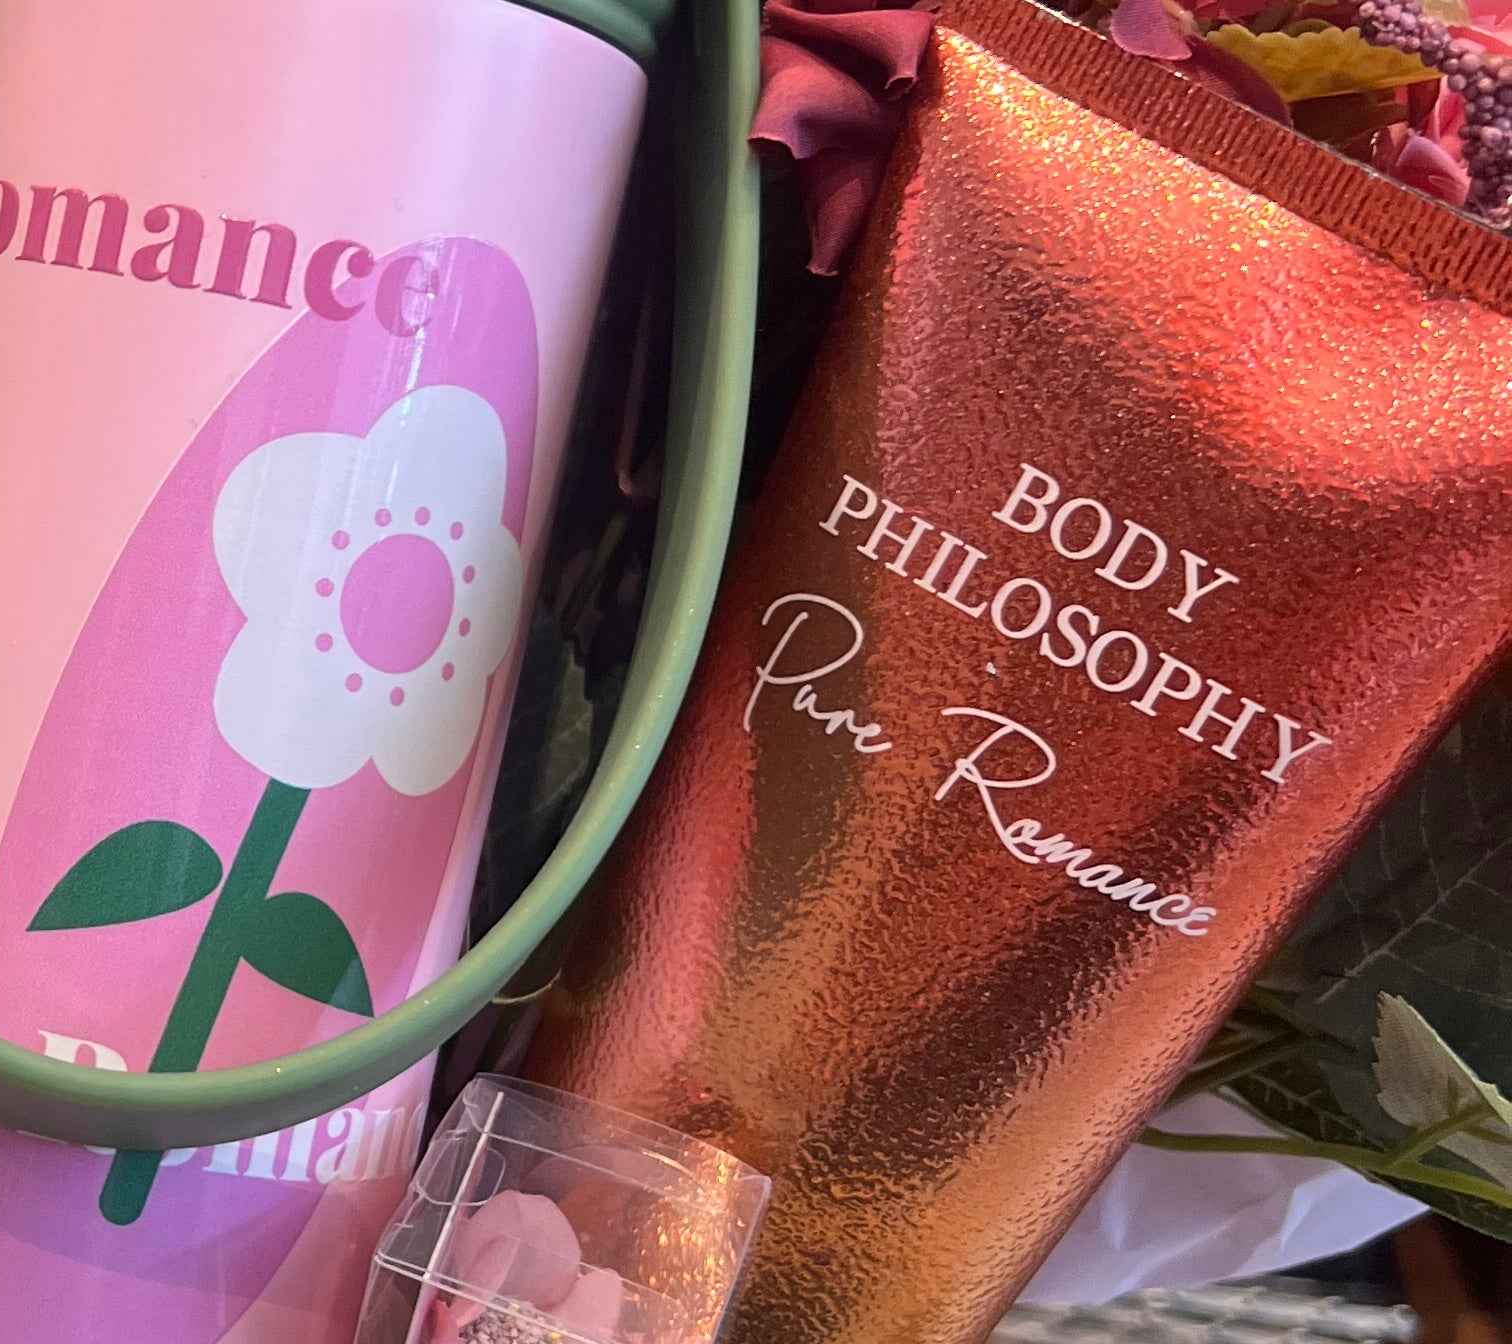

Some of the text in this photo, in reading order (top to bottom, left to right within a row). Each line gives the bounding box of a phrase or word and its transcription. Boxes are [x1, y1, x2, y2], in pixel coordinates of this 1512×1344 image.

[819, 474, 1332, 785] PHILOSOPHY
[991, 462, 1239, 623] BODY
[744, 593, 1217, 936] Pure Romance
